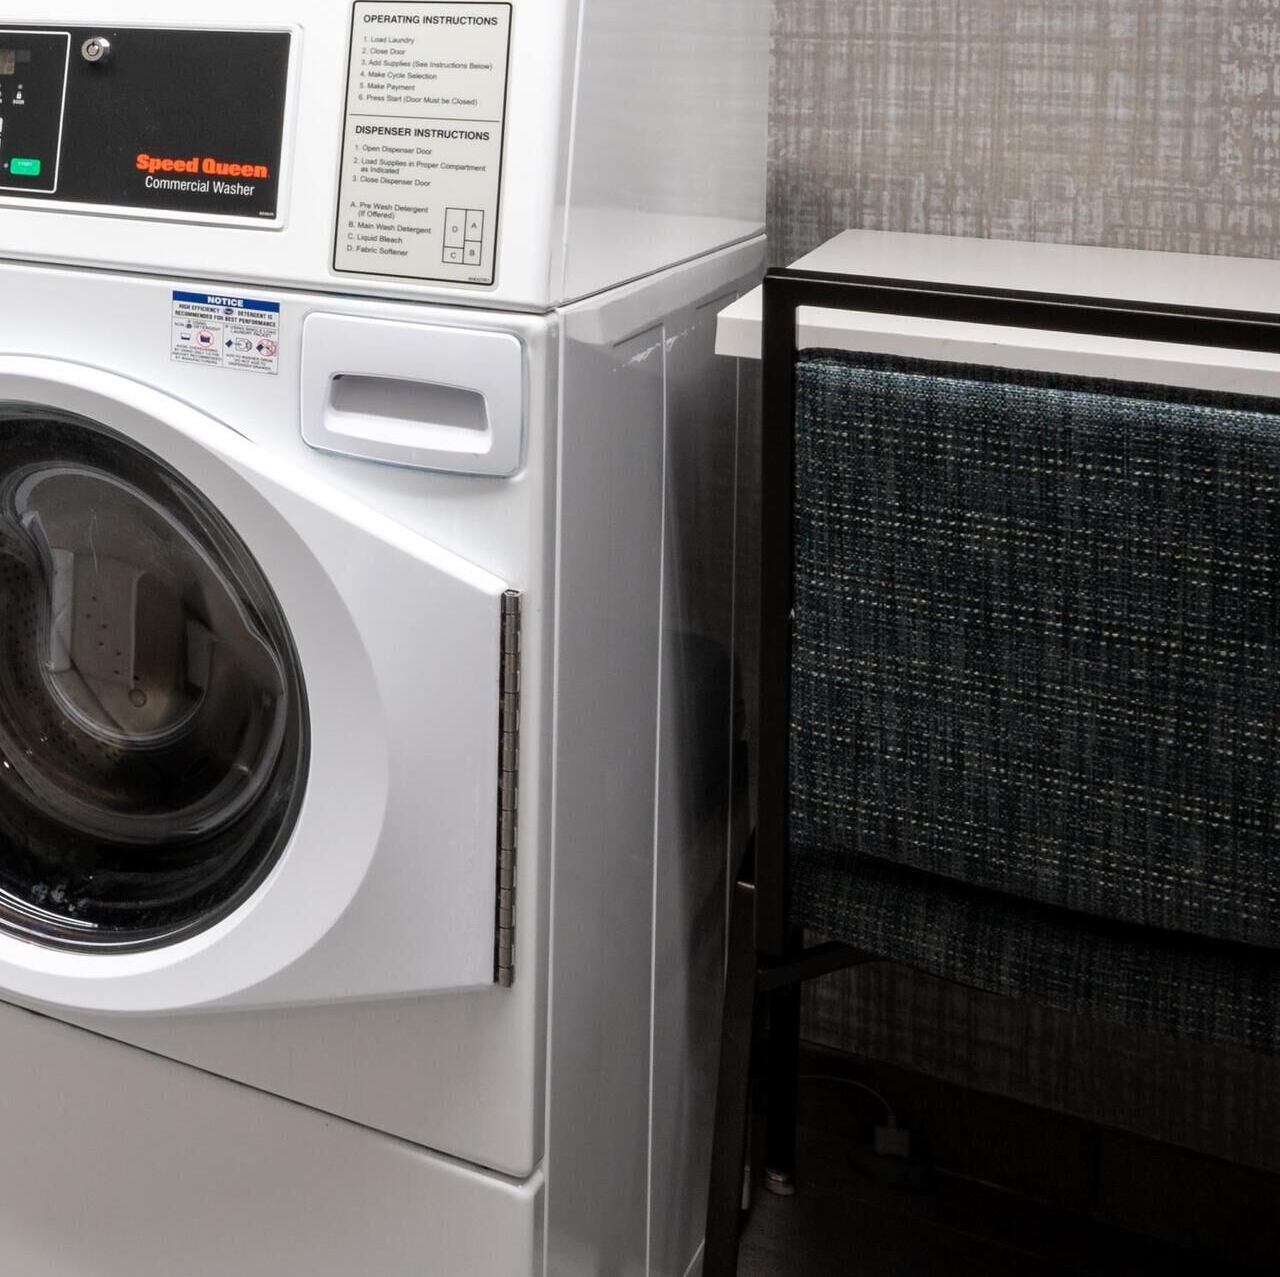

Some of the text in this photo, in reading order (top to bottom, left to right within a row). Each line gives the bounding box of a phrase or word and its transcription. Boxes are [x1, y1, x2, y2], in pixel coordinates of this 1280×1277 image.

[363, 14, 498, 26] OPERATING INSTRUCTIONS
[388, 37, 415, 45] Laundry
[383, 59, 411, 68] Supplies
[412, 60, 428, 68] (See
[429, 61, 468, 69] Instructions
[469, 62, 493, 71] Below)
[368, 70, 386, 78] Make
[387, 71, 406, 80] Cycle
[407, 72, 438, 80] Selection
[367, 82, 385, 90] Make
[386, 83, 416, 92] Payment
[366, 94, 385, 102] Press
[386, 94, 402, 102] Start
[403, 95, 422, 104] (Door
[423, 96, 440, 104] Must
[451, 98, 478, 106] Closed)
[355, 125, 490, 141] DISPENSER INSTRUCTIONS
[362, 144, 381, 153] Open
[382, 145, 415, 155] Dispenser
[416, 147, 433, 155] Door
[136, 154, 268, 178] Speed Queen
[361, 157, 378, 165] Load
[379, 158, 407, 168] Supplies
[416, 160, 439, 170] Proper
[440, 162, 486, 173] Compartment
[370, 166, 400, 174] Indicated
[145, 175, 255, 196] Commercial Washer
[360, 176, 379, 184] Close
[380, 176, 413, 187] Dispenser
[414, 179, 431, 187] Door
[373, 202, 393, 211] Wash
[394, 203, 429, 214] Detergent
[366, 211, 395, 220] Offered)
[357, 221, 375, 229] Main
[376, 222, 396, 231] Wash
[397, 224, 432, 235] Detergent
[357, 233, 378, 243] Liquid
[379, 235, 403, 244] Bleach
[356, 245, 378, 254] Fabric
[379, 247, 409, 257] Softener
[207, 296, 244, 307] NOTICE
